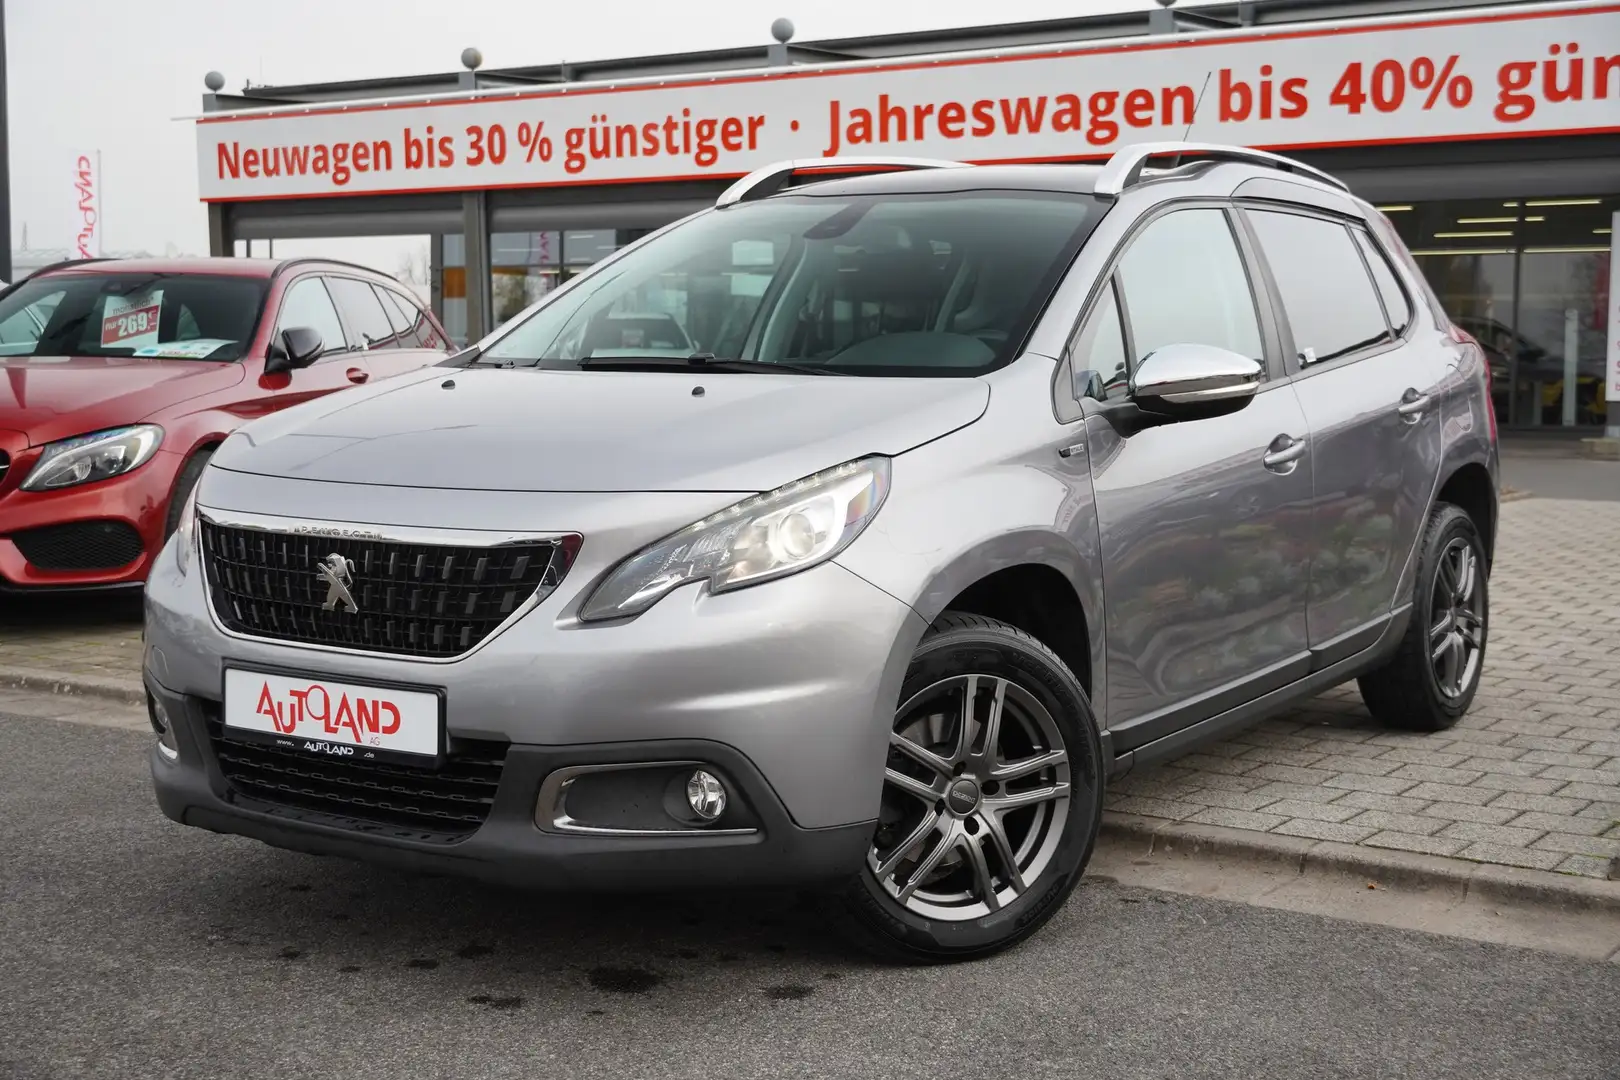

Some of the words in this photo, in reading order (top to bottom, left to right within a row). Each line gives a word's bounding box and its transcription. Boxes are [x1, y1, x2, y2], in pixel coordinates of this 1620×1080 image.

[217, 140, 393, 187] Neuwagen
[403, 126, 455, 169] bis
[465, 123, 507, 167] 30
[517, 121, 553, 163] %
[563, 107, 766, 175] günstiger
[822, 85, 1195, 158] Jahreswagen
[1218, 63, 1309, 124] bis
[1329, 55, 1474, 115] 40%
[1493, 42, 1620, 124] gün
[256, 680, 401, 743] AUTOLAND
[304, 741, 354, 756] AUTOLAND
[369, 736, 381, 747] AG
